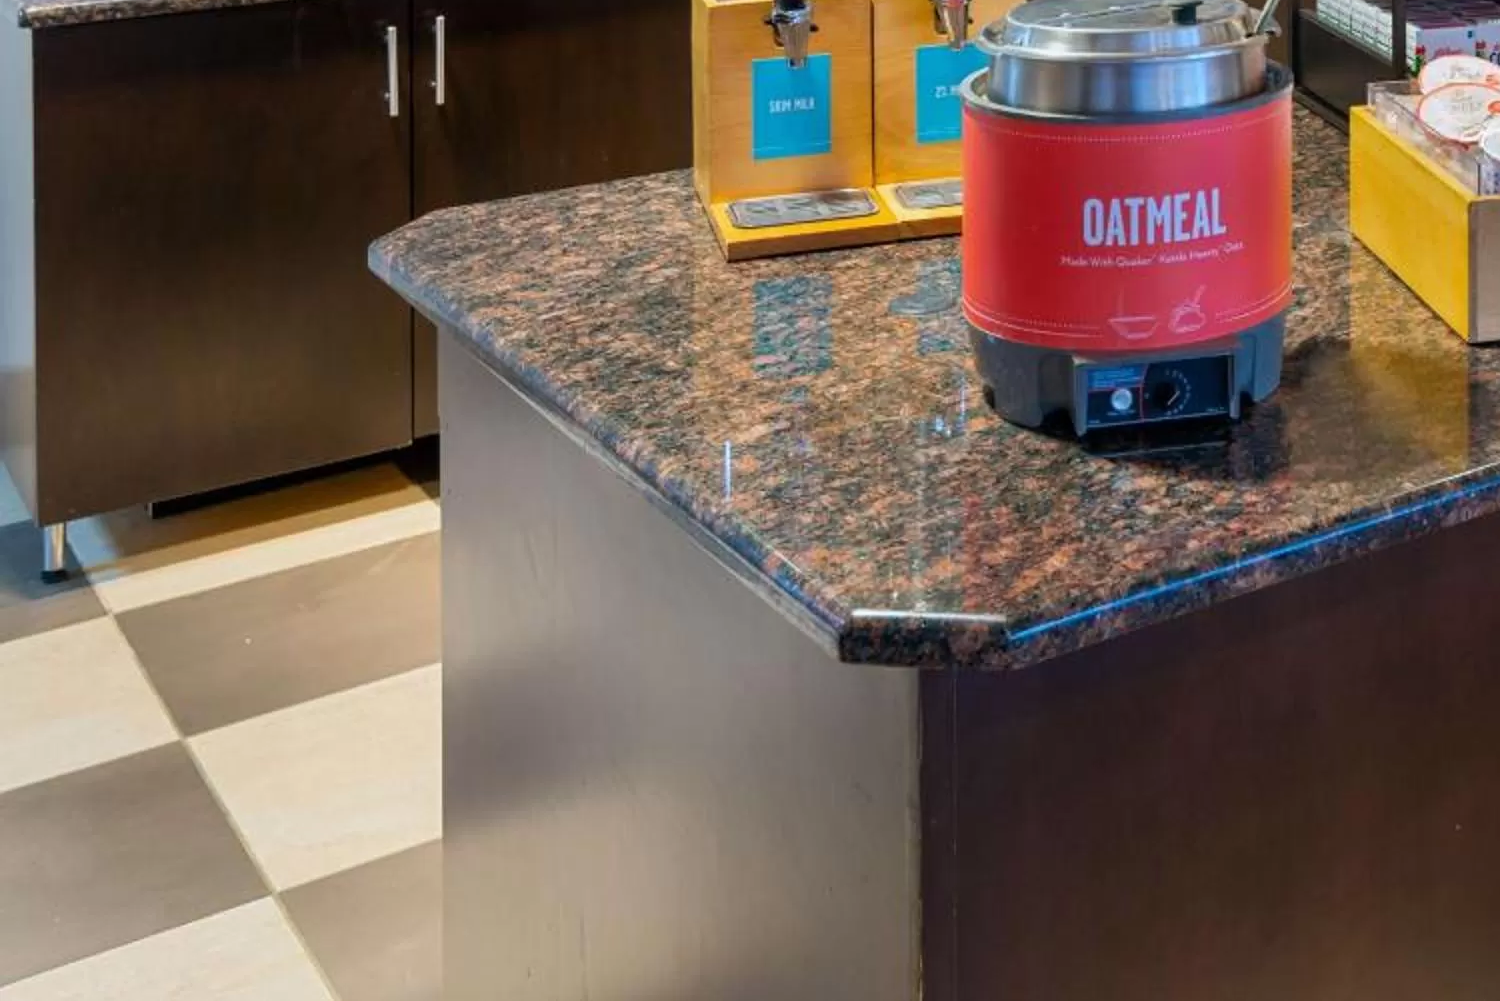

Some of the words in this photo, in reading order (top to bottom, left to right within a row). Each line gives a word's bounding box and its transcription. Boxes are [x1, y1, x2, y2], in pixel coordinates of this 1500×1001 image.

[769, 99, 792, 113] SKIM
[794, 97, 816, 111] MILK
[1083, 187, 1227, 247] OATMEAL
[1060, 255, 1088, 267] Made
[1090, 255, 1113, 268] With
